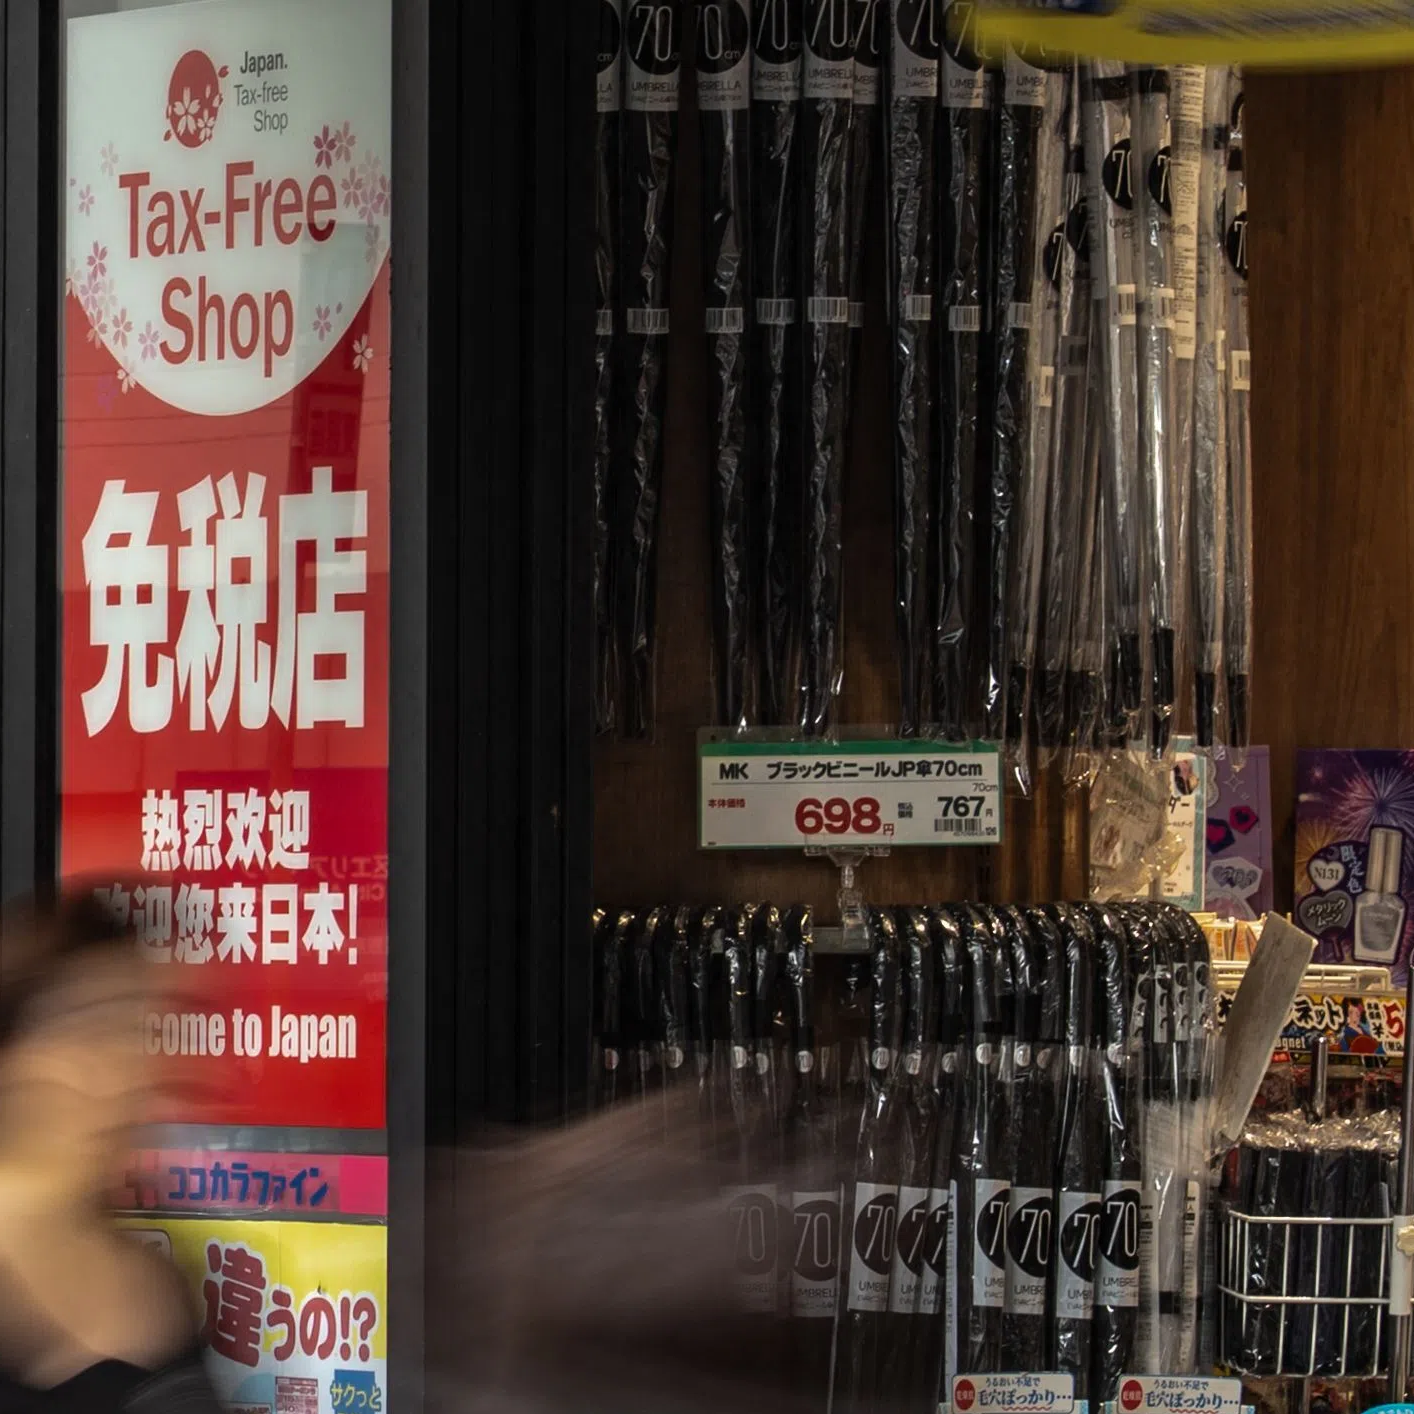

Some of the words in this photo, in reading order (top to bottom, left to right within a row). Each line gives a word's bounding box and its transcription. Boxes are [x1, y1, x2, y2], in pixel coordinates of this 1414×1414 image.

[636, 5, 672, 61] 70
[239, 51, 288, 78] Japan.
[233, 82, 288, 107] Tax-free
[253, 110, 288, 135] Shop
[119, 160, 337, 259] Tax-Free
[159, 276, 294, 378] Shop
[80, 466, 369, 738] 免税店
[719, 762, 748, 780] MK
[972, 782, 998, 793] 70cm
[141, 787, 310, 871] 热烈欢迎
[794, 797, 882, 835] 698
[882, 823, 895, 836] 円
[937, 796, 986, 818] 767
[1313, 863, 1341, 881] N131
[1340, 845, 1365, 894] 限定色
[143, 1006, 226, 1058] come
[232, 1008, 263, 1058] to
[268, 1006, 357, 1063] Japan
[168, 1161, 330, 1207] ココカラファイン
[794, 1212, 831, 1267] 70
[1020, 1208, 1051, 1265] 70
[1106, 1201, 1136, 1258] 70
[202, 1243, 377, 1368] 違うの!?
[330, 1382, 382, 1411] サクっと
[985, 1377, 1041, 1388] うるおい不足で
[1153, 1379, 1209, 1390] うるおい不足で
